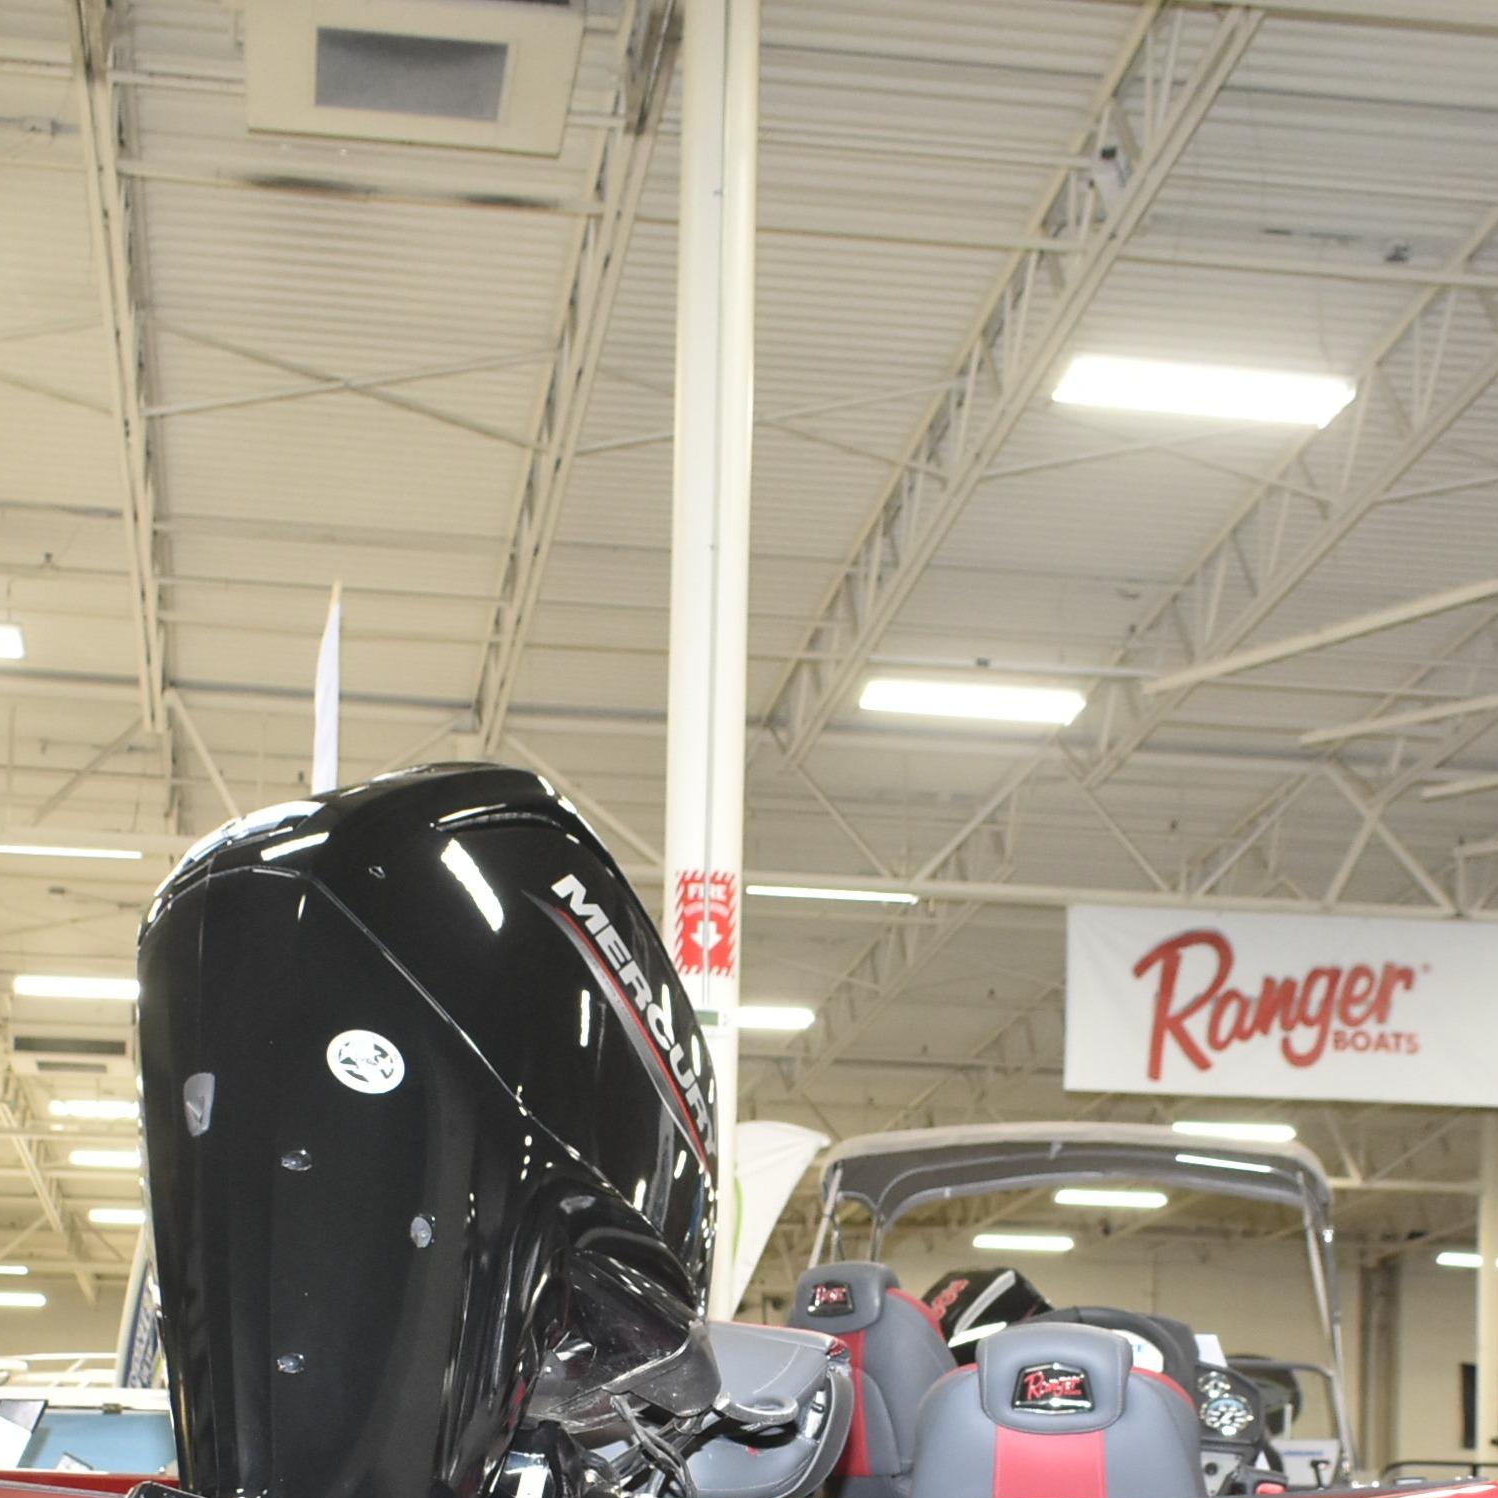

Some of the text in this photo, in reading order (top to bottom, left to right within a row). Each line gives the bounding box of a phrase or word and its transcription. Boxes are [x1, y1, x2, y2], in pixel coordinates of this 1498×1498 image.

[551, 873, 719, 1156] MERCURY
[1133, 928, 1415, 1082] Ranger
[1333, 1030, 1420, 1055] BOATS
